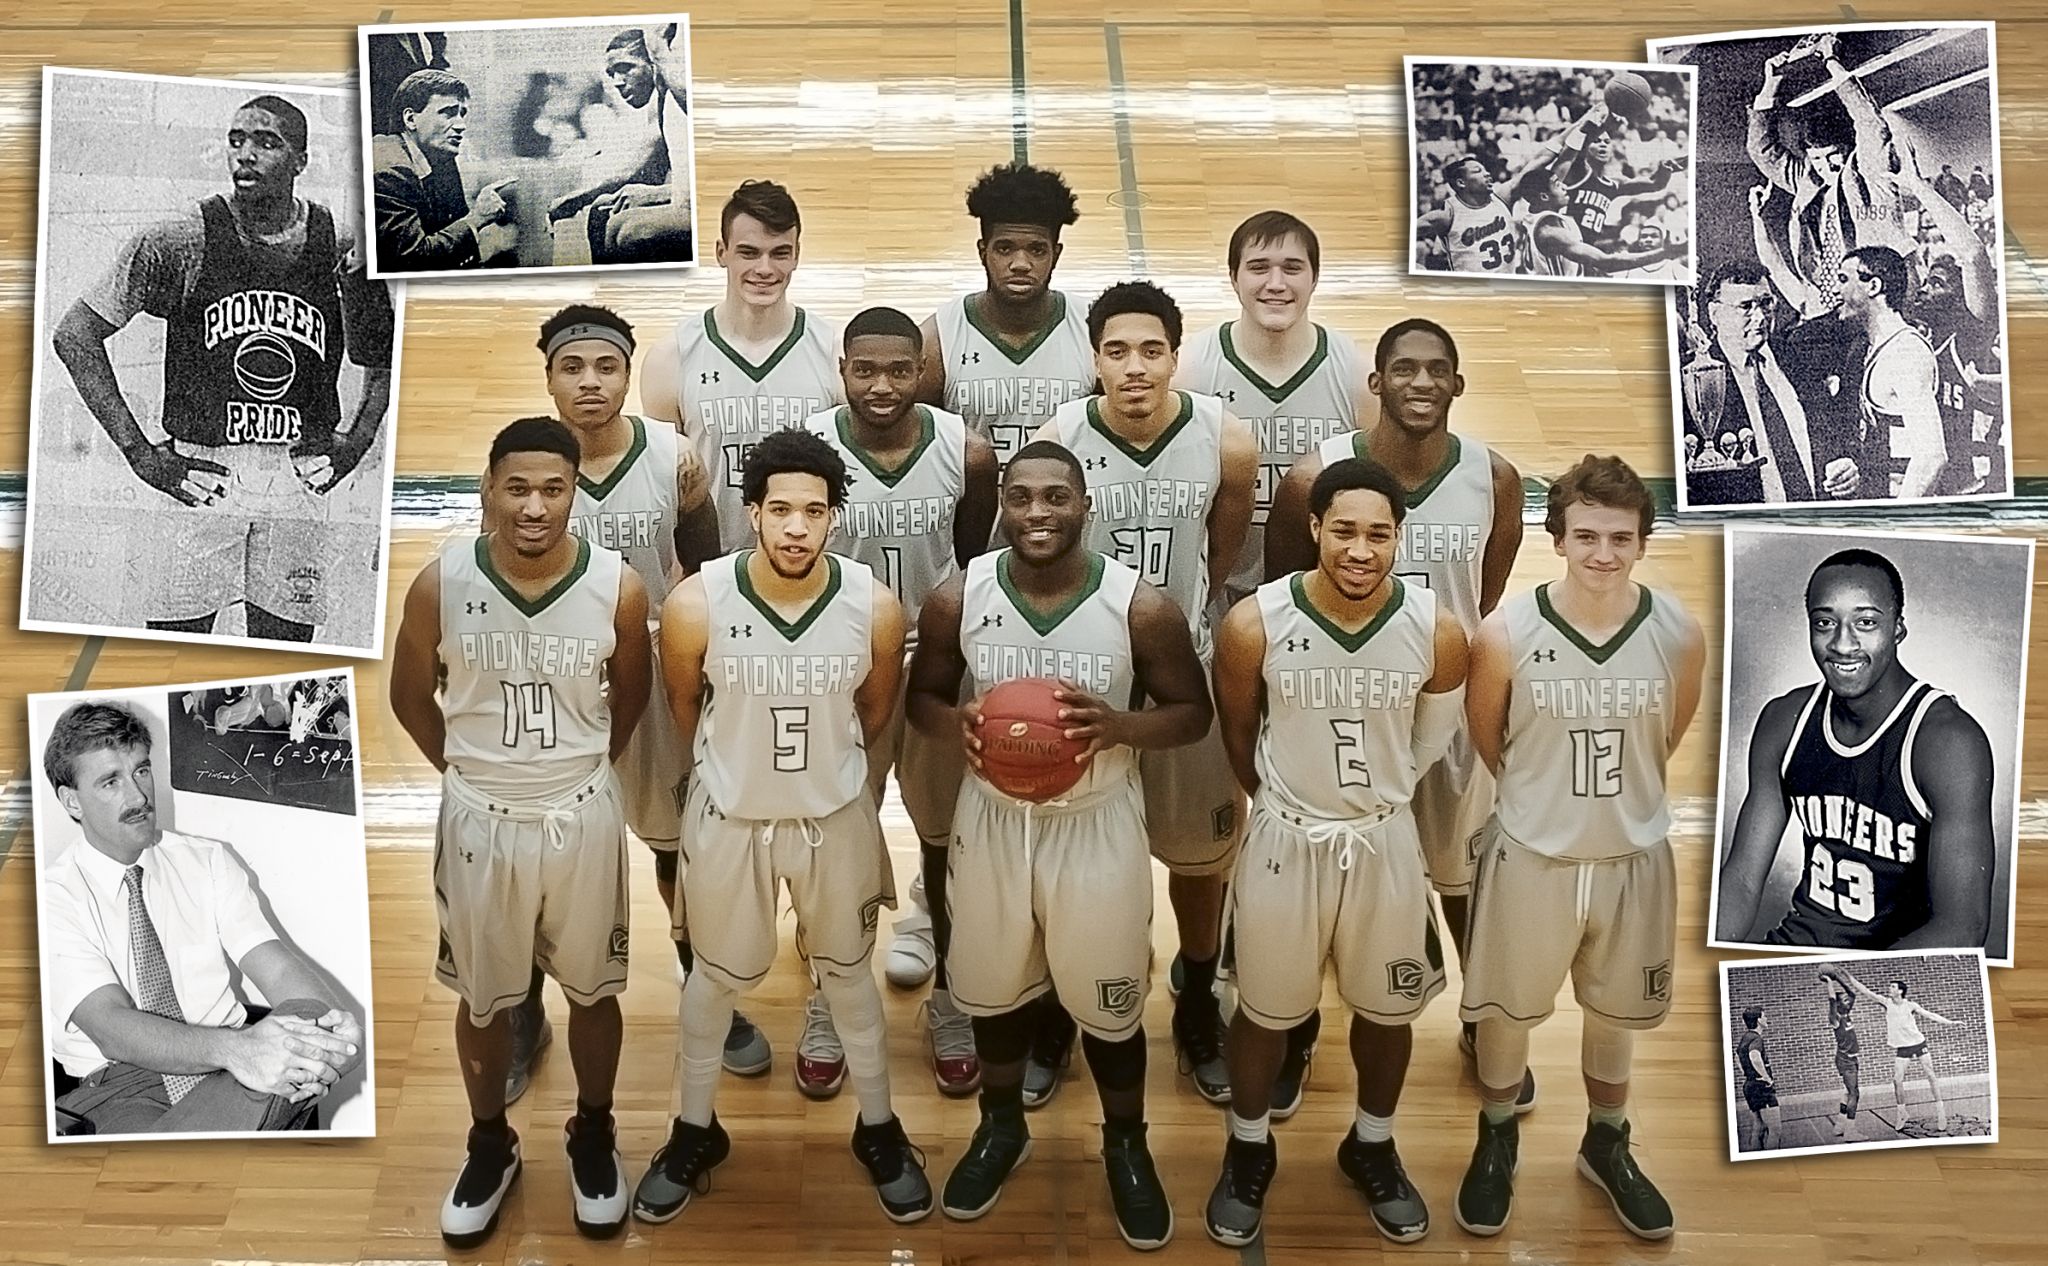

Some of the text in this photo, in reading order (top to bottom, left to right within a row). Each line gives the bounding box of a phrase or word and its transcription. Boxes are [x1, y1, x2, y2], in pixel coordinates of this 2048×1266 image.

[1581, 208, 1605, 233] 20
[1479, 232, 1516, 270] 33
[205, 290, 326, 362] PIONEER
[226, 401, 302, 443] PRIDE
[1110, 526, 1174, 588] 20
[1394, 523, 1481, 562] NEERS
[459, 630, 599, 678] PIONEERS
[722, 654, 860, 697] PIONEERS
[975, 642, 1113, 695] PIONEERS
[500, 679, 557, 749] 14
[1279, 666, 1422, 711] PIONEERS
[1530, 677, 1667, 720] PIONEERS
[769, 706, 809, 772] 5
[1329, 718, 1371, 788] 2
[1568, 728, 1625, 798] 12
[1794, 794, 1916, 864] IONEERS
[1809, 843, 1875, 923] 23
